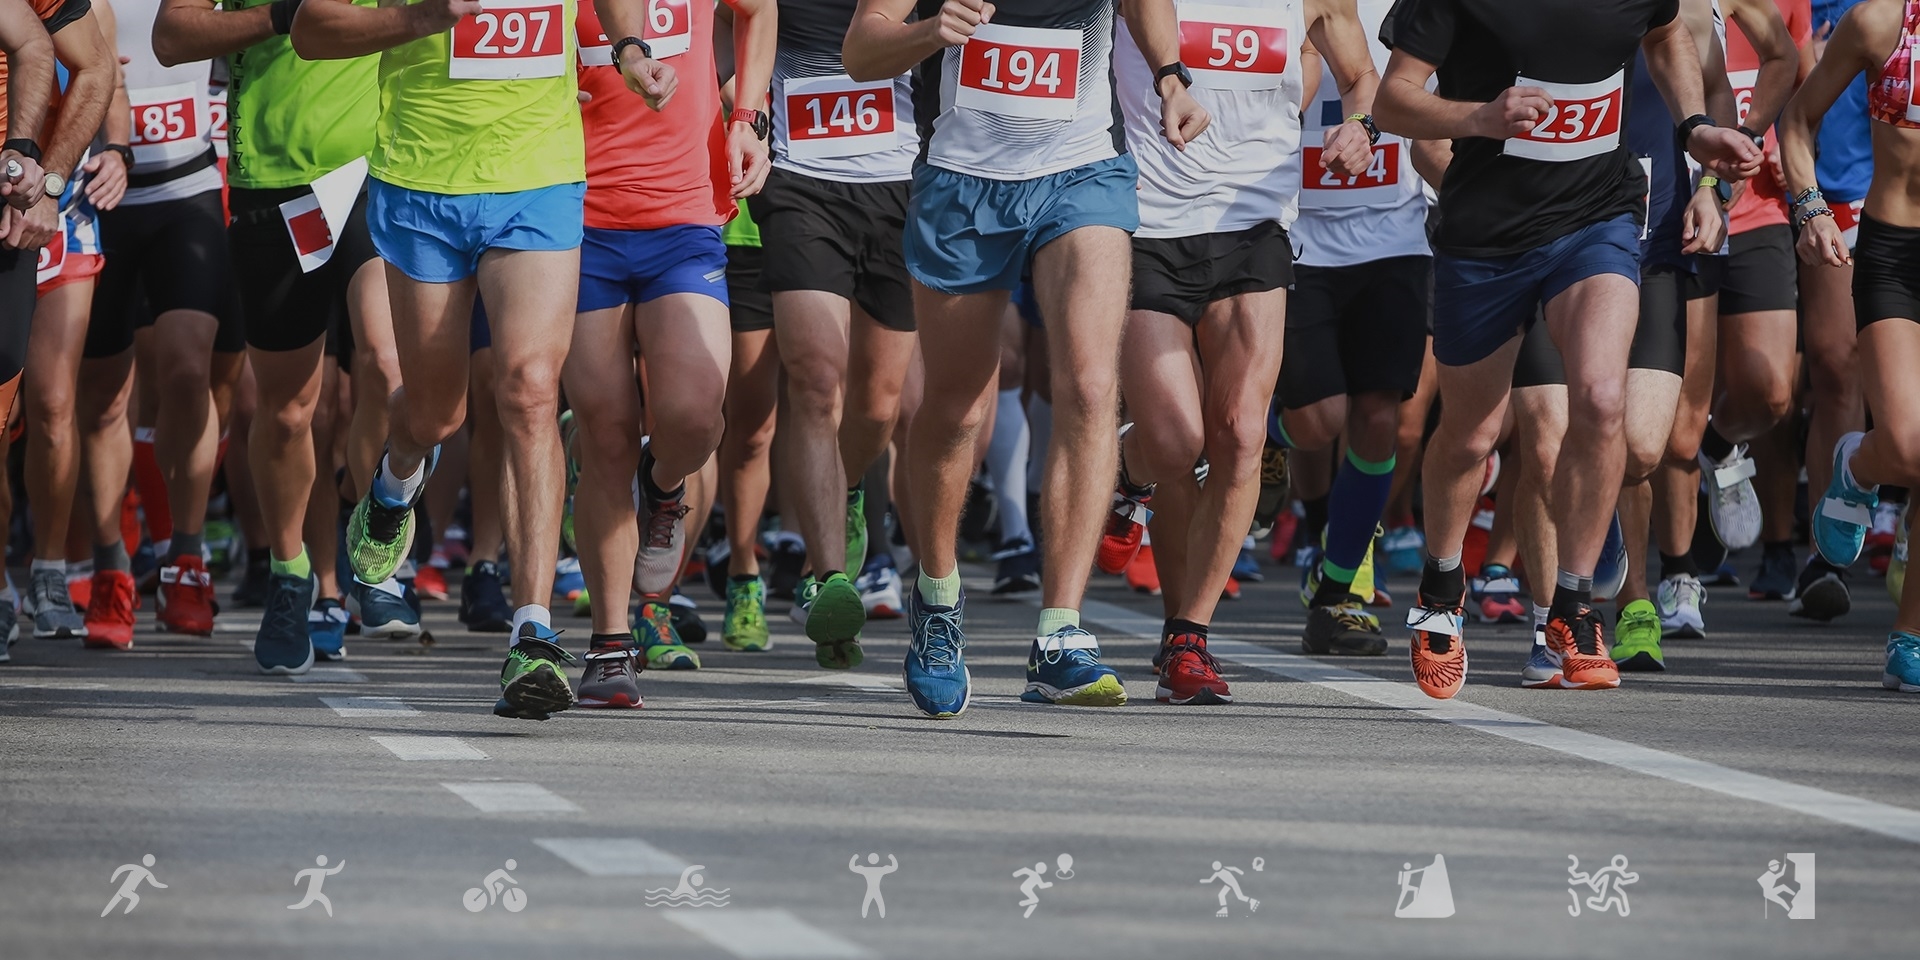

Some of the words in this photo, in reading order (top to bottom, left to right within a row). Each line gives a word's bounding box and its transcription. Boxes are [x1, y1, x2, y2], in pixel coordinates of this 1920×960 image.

[474, 10, 550, 54] 297
[1207, 26, 1261, 69] 59
[980, 45, 1062, 94] 194
[130, 103, 186, 143] 185
[804, 93, 880, 137] 146
[1530, 96, 1612, 141] 237
